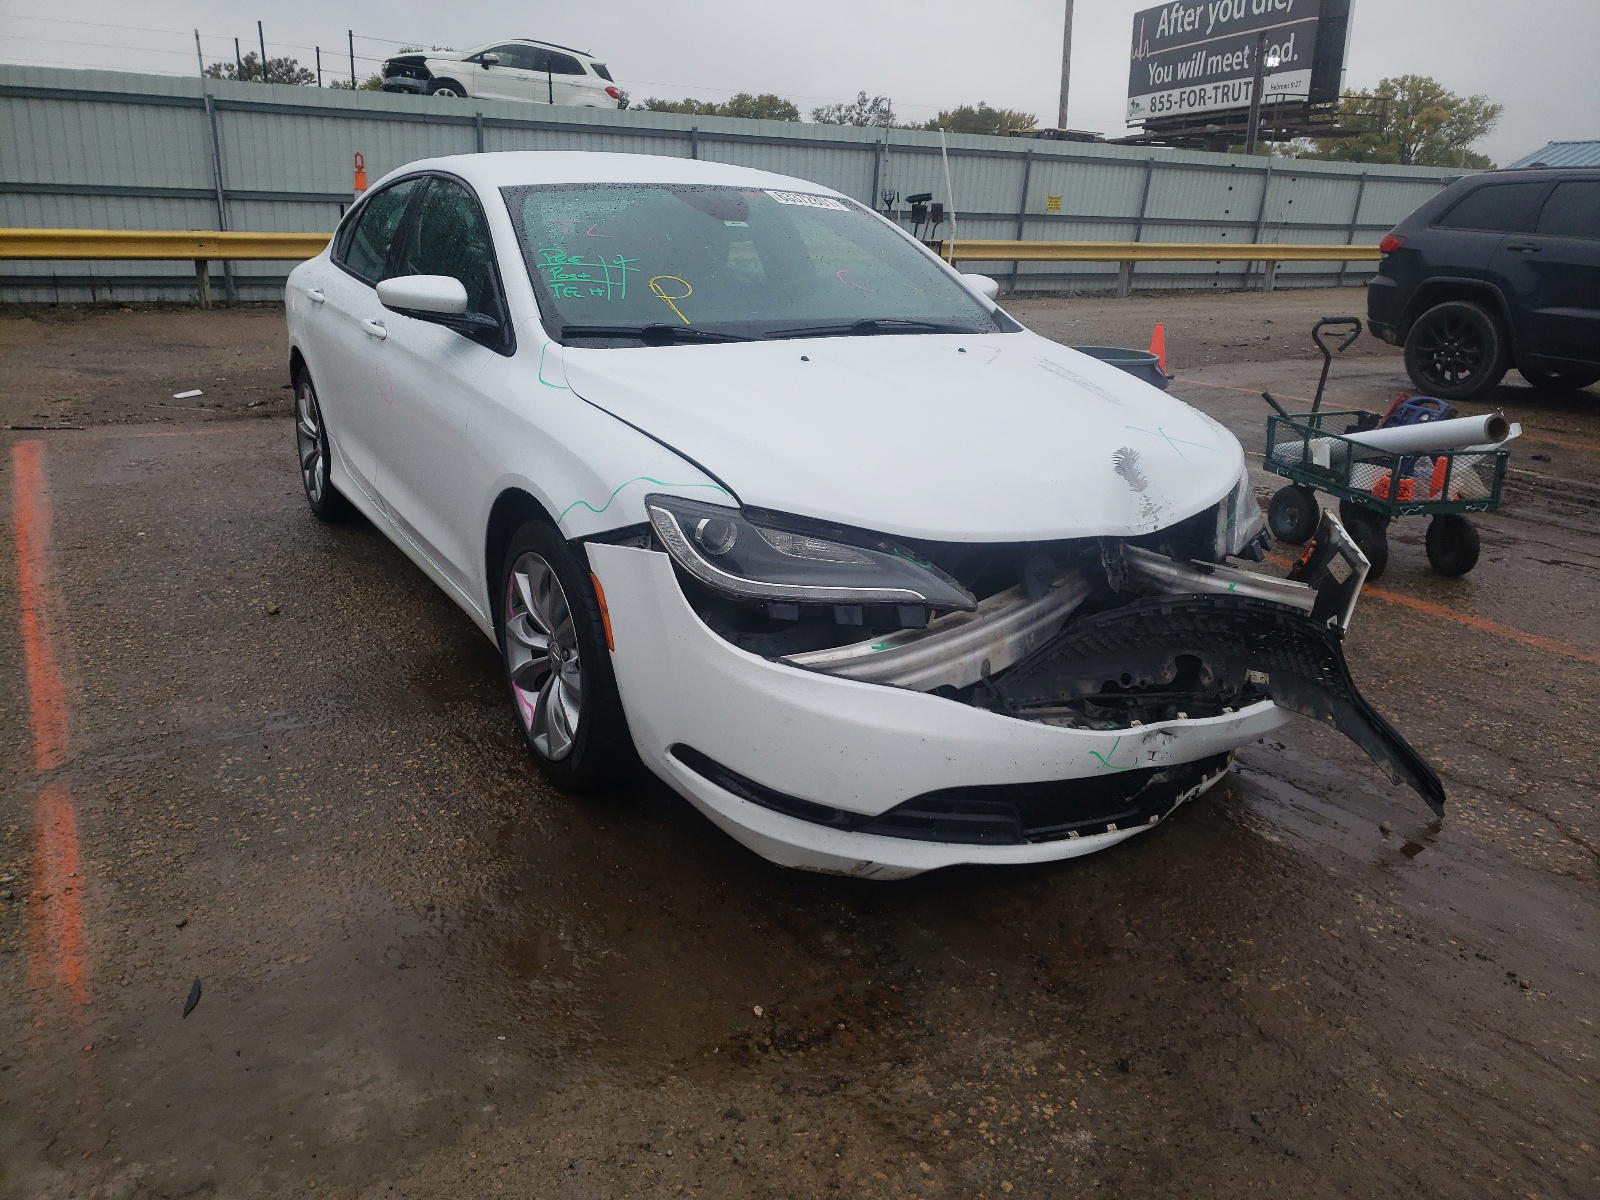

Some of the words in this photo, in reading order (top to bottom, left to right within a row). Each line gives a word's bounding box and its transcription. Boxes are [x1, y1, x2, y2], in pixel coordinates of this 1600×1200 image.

[1156, 2, 1204, 39] After
[1206, 0, 1247, 35] you
[1148, 62, 1174, 86] You
[1177, 50, 1207, 80] will
[1207, 44, 1250, 75] meet
[1254, 32, 1298, 66] od.
[1150, 80, 1258, 113] 855-FOR-TRUT
